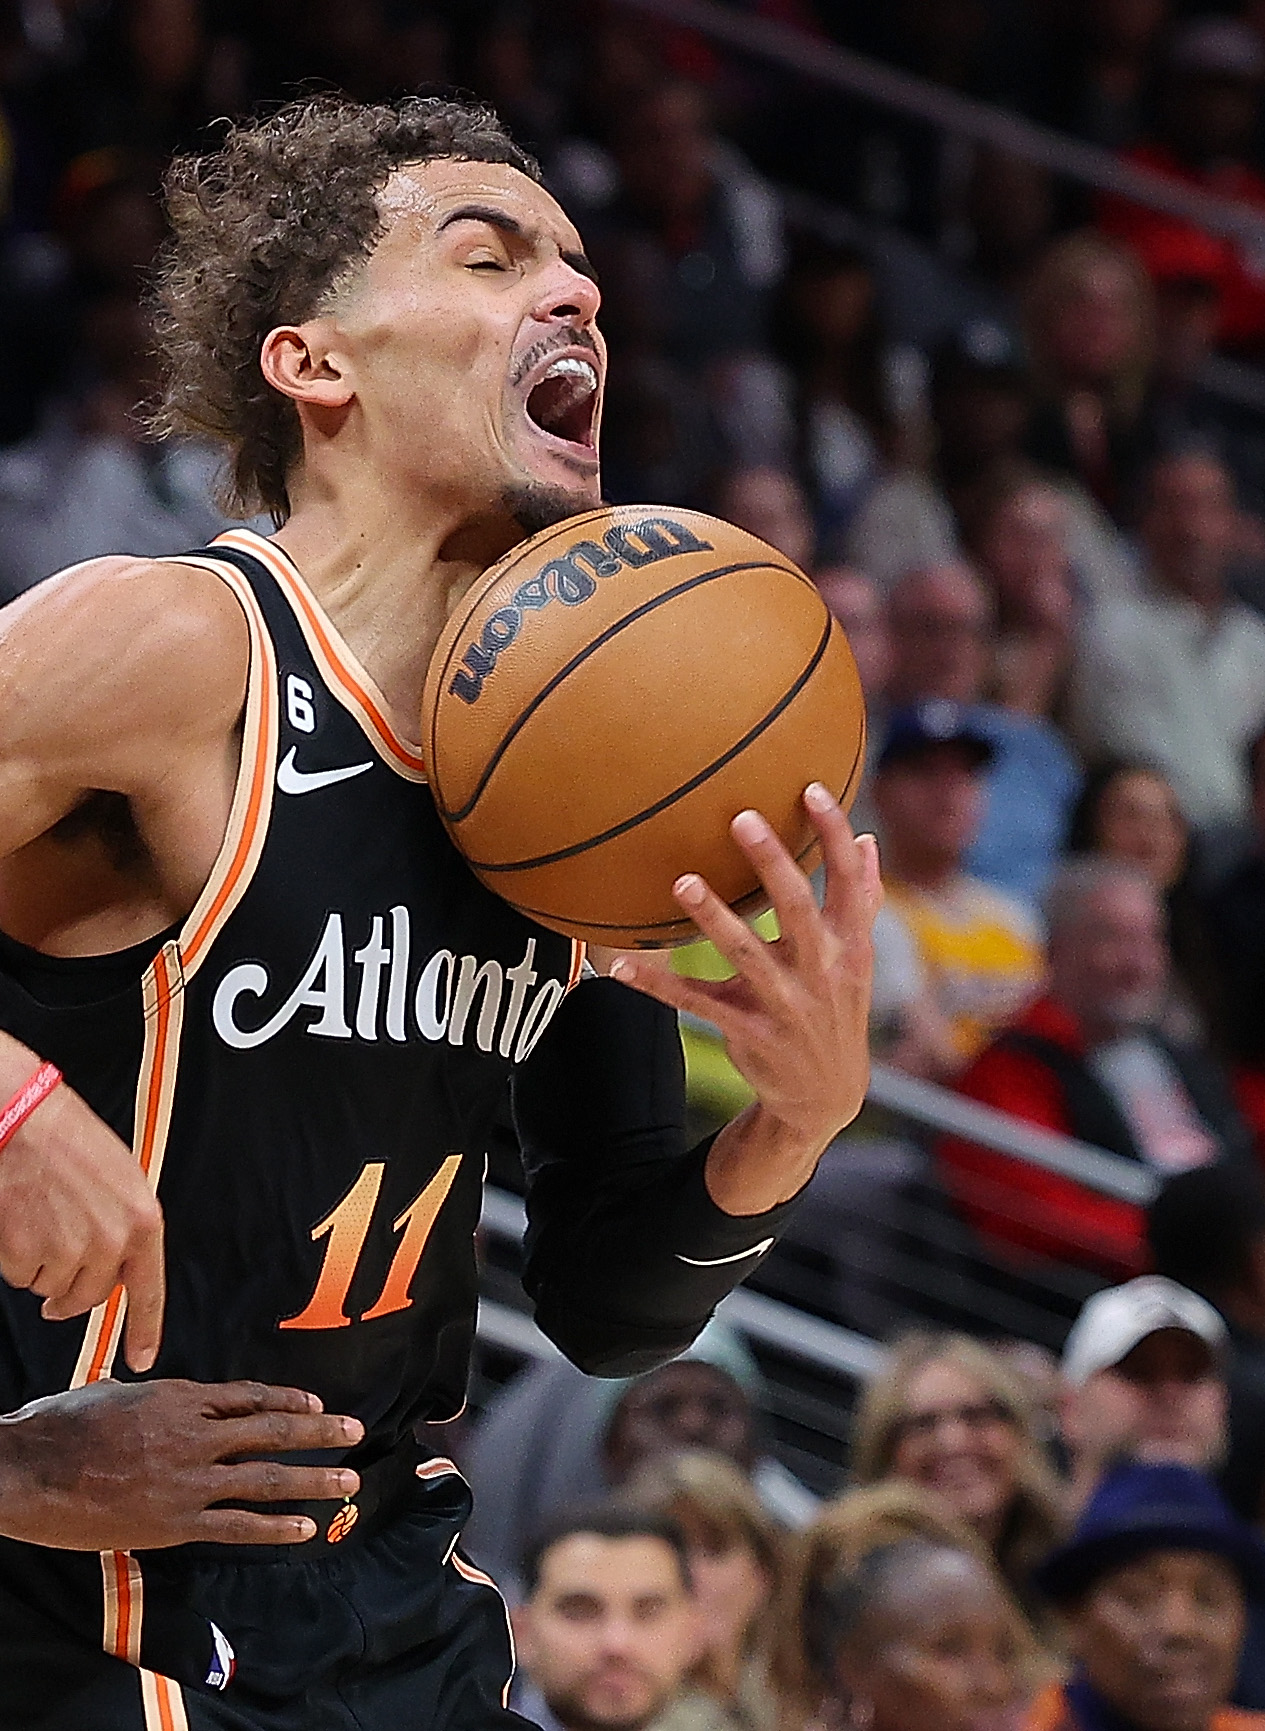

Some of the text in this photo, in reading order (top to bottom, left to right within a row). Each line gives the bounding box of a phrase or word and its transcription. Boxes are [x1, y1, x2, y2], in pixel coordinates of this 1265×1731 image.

[449, 518, 713, 704] Wilson
[287, 675, 315, 733] 6
[279, 1154, 463, 1330] 11
